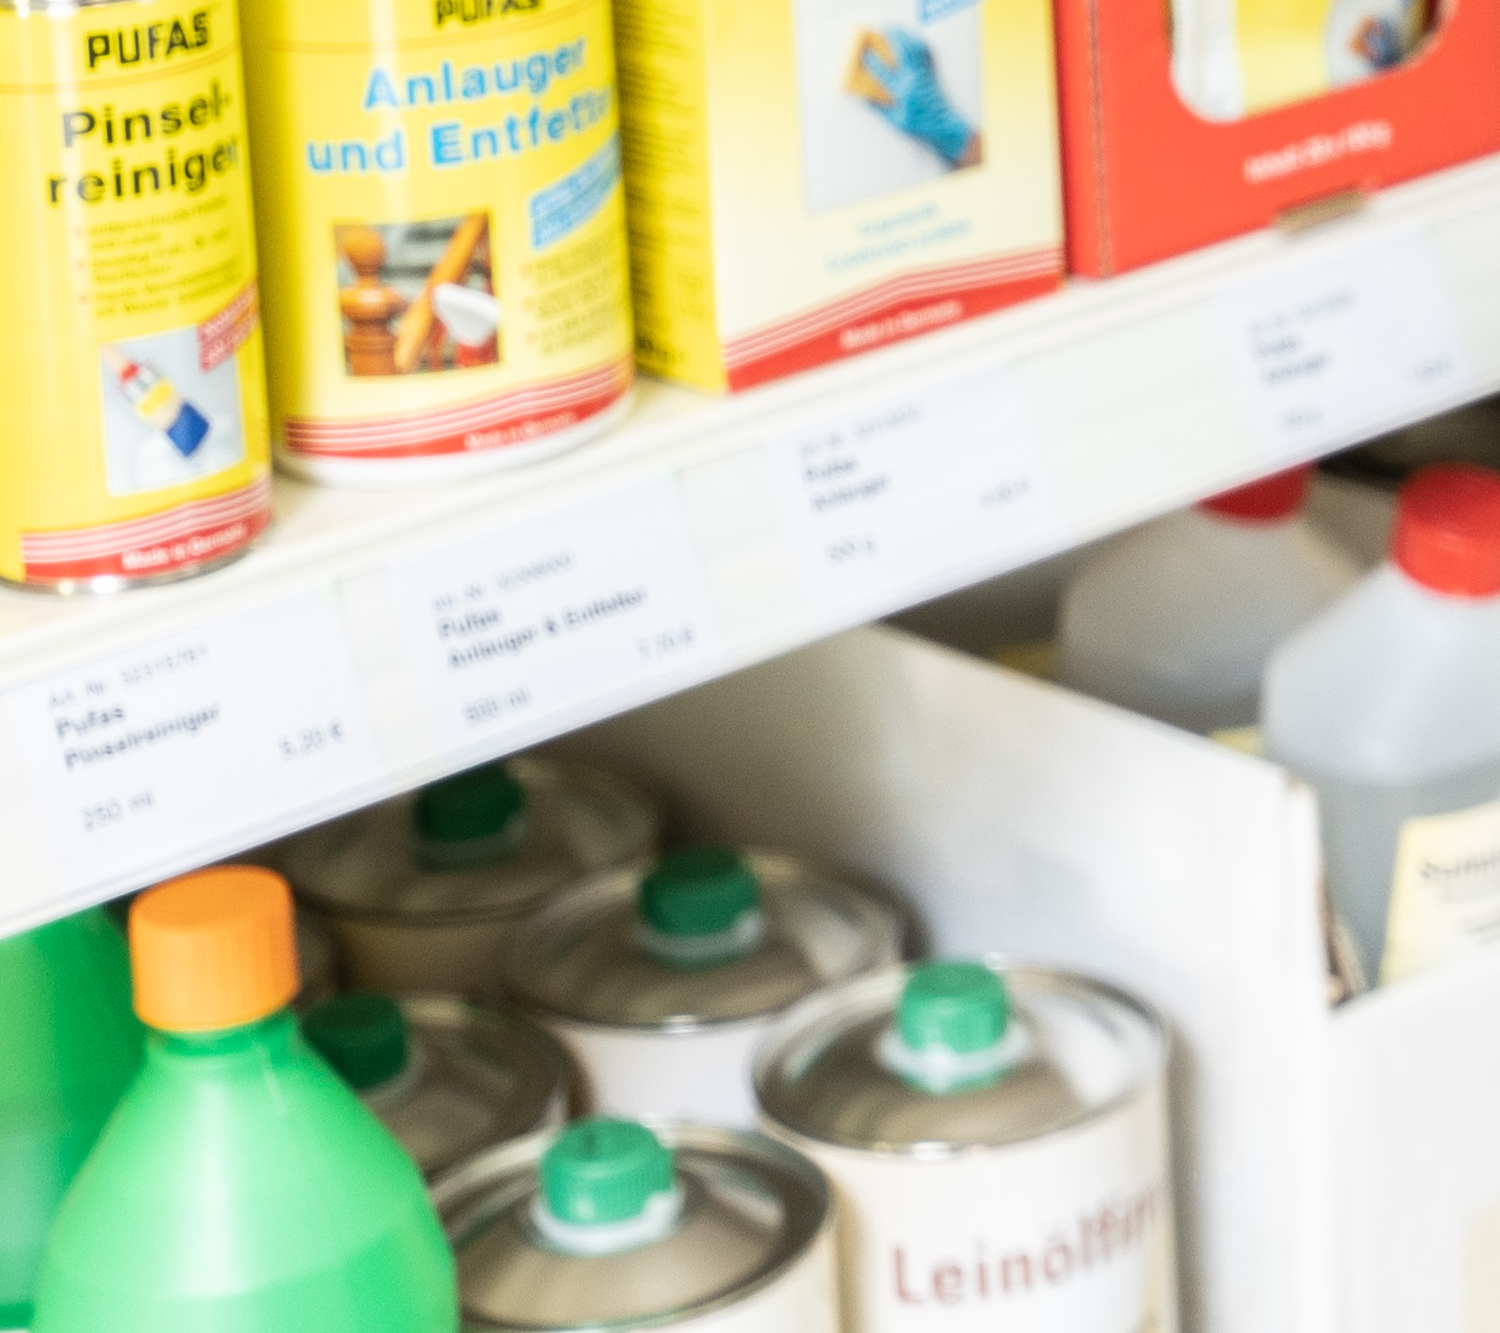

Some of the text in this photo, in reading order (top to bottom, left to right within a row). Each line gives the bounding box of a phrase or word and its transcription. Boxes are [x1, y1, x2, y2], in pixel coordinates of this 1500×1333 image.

[87, 10, 209, 68] PUFAS
[364, 37, 586, 110] Anlauger
[62, 79, 233, 148] Pinsel-
[47, 136, 239, 203] reiniger
[305, 131, 406, 173] und
